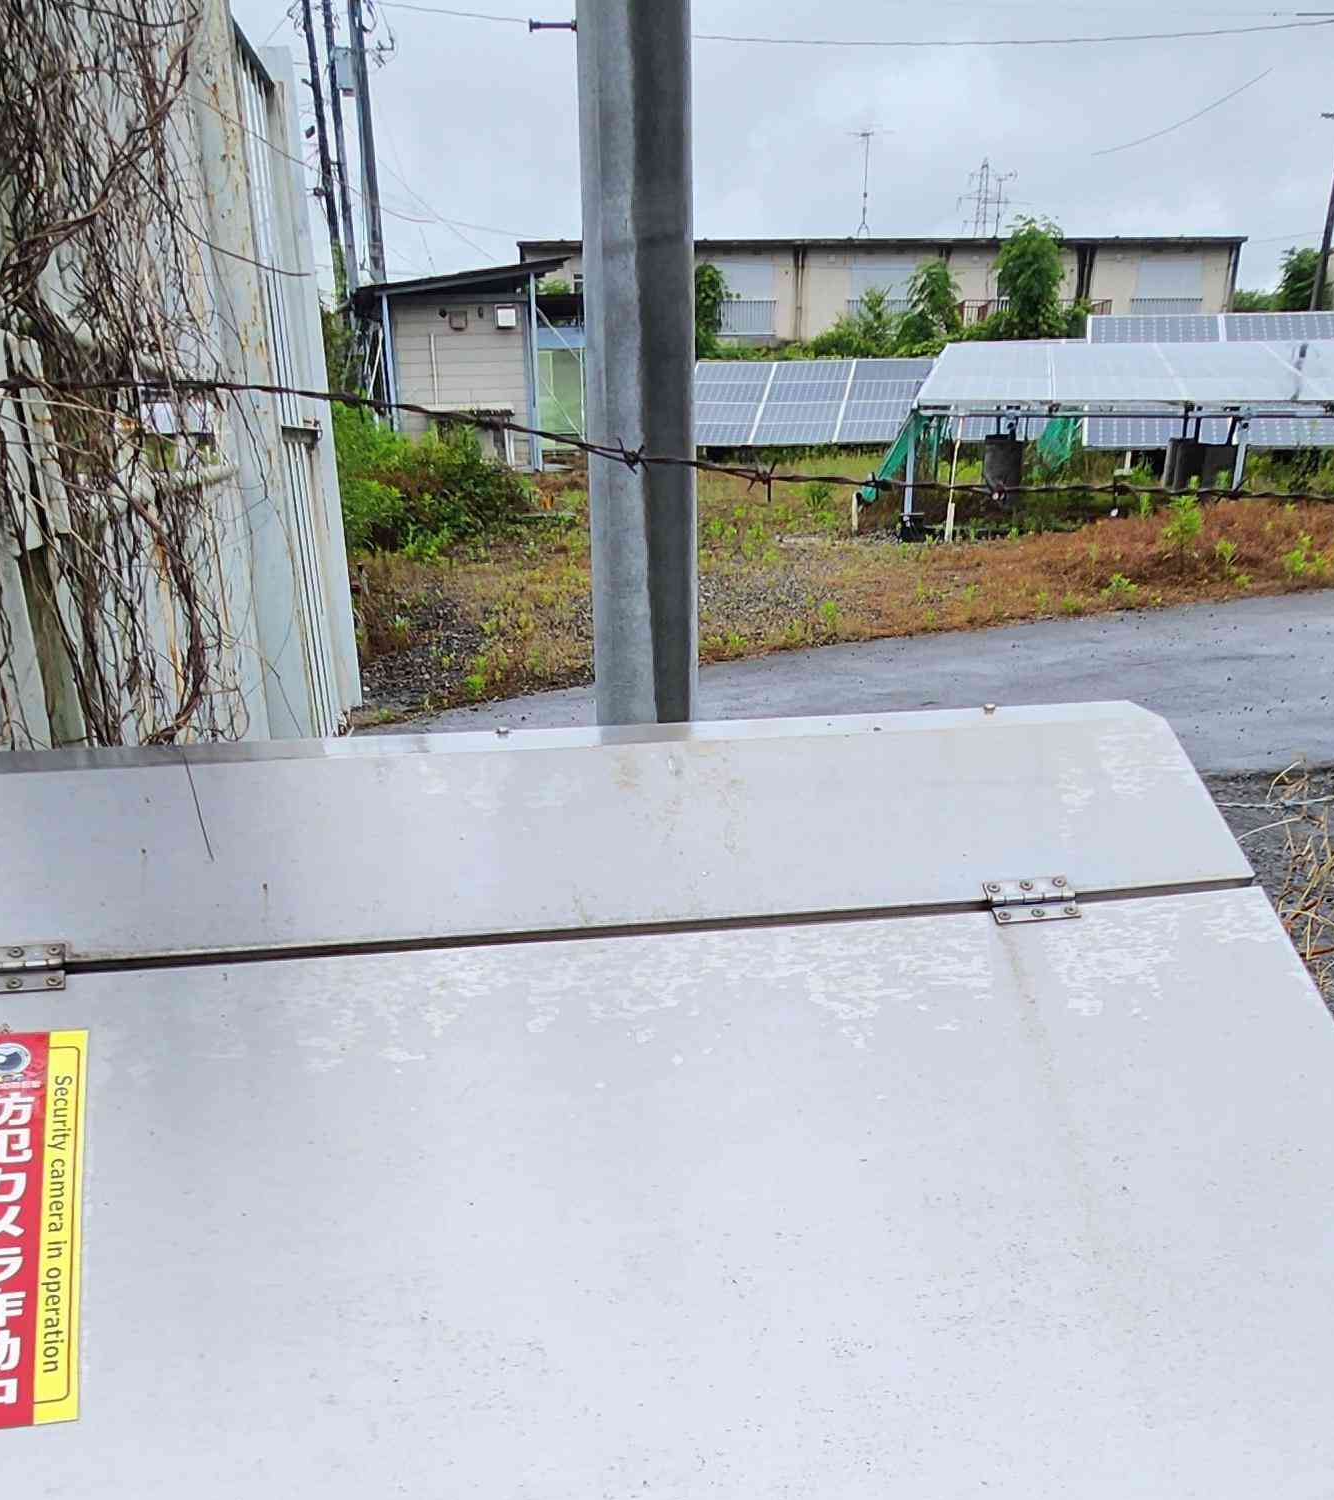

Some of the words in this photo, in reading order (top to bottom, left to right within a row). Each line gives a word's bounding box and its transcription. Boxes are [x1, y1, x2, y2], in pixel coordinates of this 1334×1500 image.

[47, 1075, 73, 1151] Security
[48, 1158, 66, 1233] camera
[46, 1241, 68, 1259] in
[41, 1267, 64, 1373] operation
